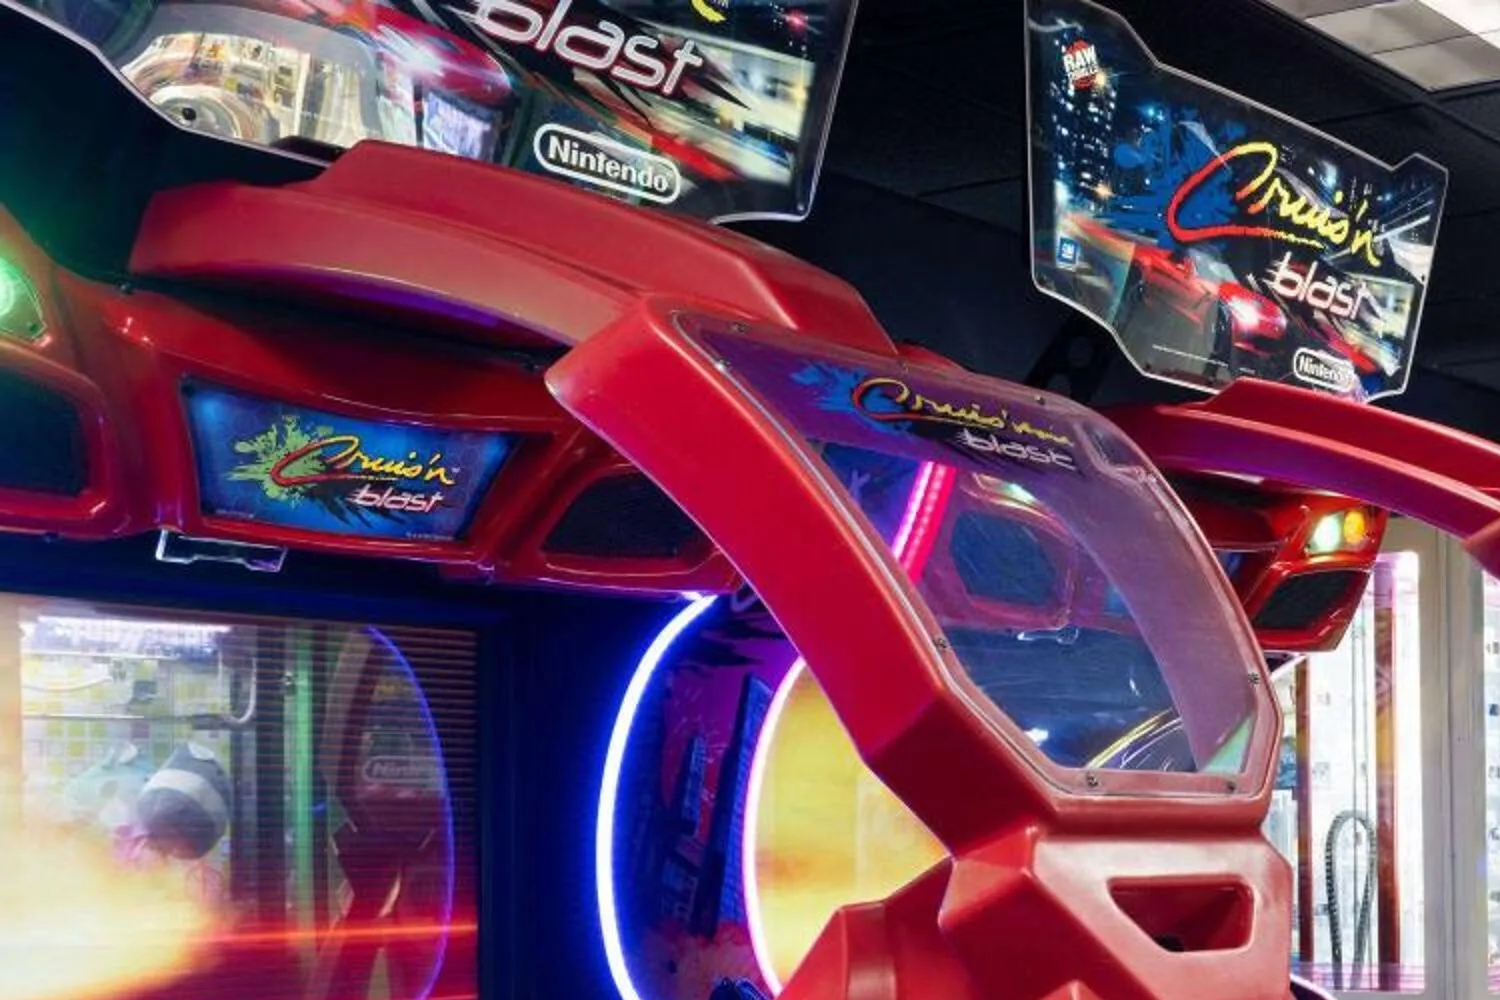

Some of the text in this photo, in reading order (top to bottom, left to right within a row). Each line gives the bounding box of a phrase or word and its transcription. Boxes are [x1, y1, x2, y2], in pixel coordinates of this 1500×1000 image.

[1063, 45, 1098, 73] RAW
[548, 135, 670, 193] Nintendo
[1266, 251, 1367, 320] blast
[270, 435, 455, 487] Cruis'n
[954, 428, 1078, 471] blast
[347, 483, 444, 513] blast
